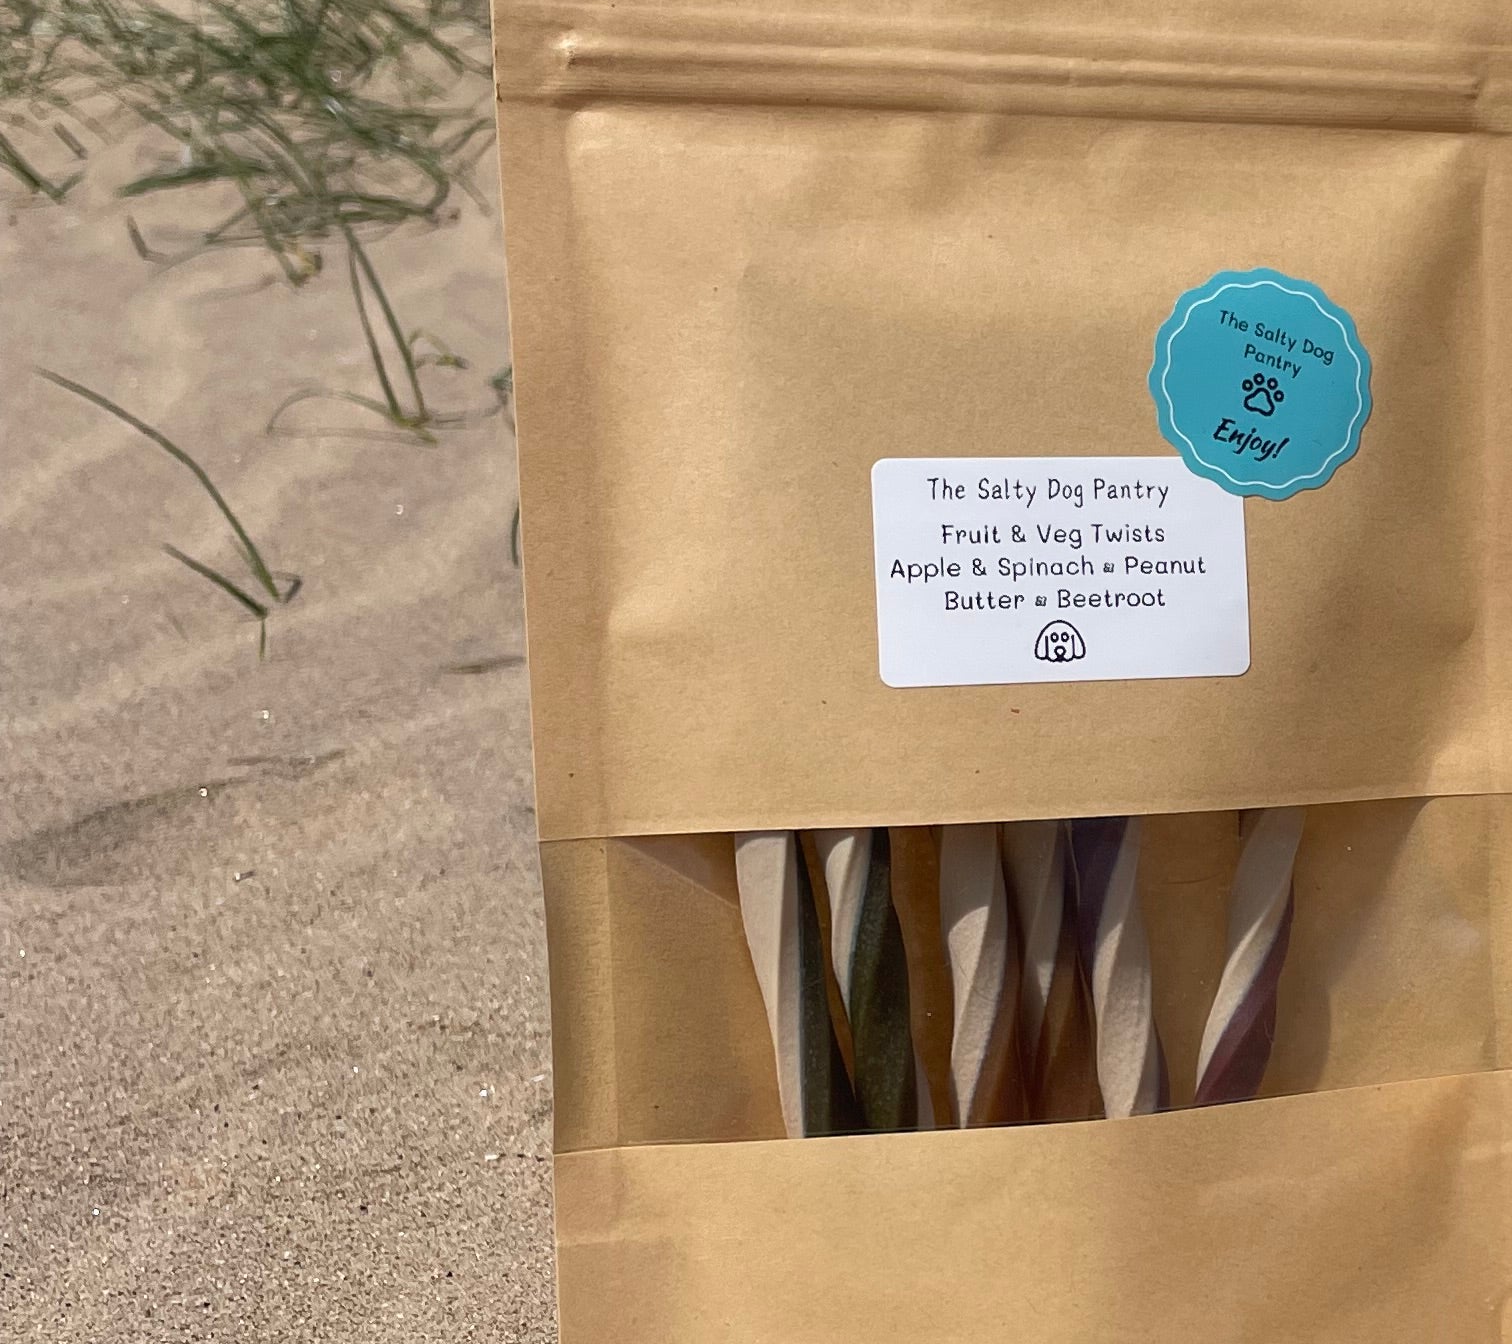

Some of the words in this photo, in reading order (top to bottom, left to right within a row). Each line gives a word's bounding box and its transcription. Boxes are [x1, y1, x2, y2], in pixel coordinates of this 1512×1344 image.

[1219, 310, 1249, 332] The
[1254, 322, 1297, 352] Salty
[1302, 338, 1335, 366] Dog
[1244, 344, 1302, 378] Pantry
[1213, 418, 1290, 462] Enjoy!
[926, 477, 966, 500] The
[978, 477, 1037, 509] Salty
[1047, 478, 1084, 509] Dog
[1093, 477, 1169, 509] Pantry
[941, 523, 1001, 545] Fruit
[1011, 524, 1027, 543] &
[1036, 524, 1083, 550] Veg
[1090, 523, 1165, 544] Twists
[890, 556, 961, 584] Apple
[972, 557, 987, 577] &
[998, 554, 1095, 583] Spinach
[1124, 555, 1207, 575] Peanut
[944, 590, 1025, 611] Butter
[1057, 588, 1166, 609] Beetroot
